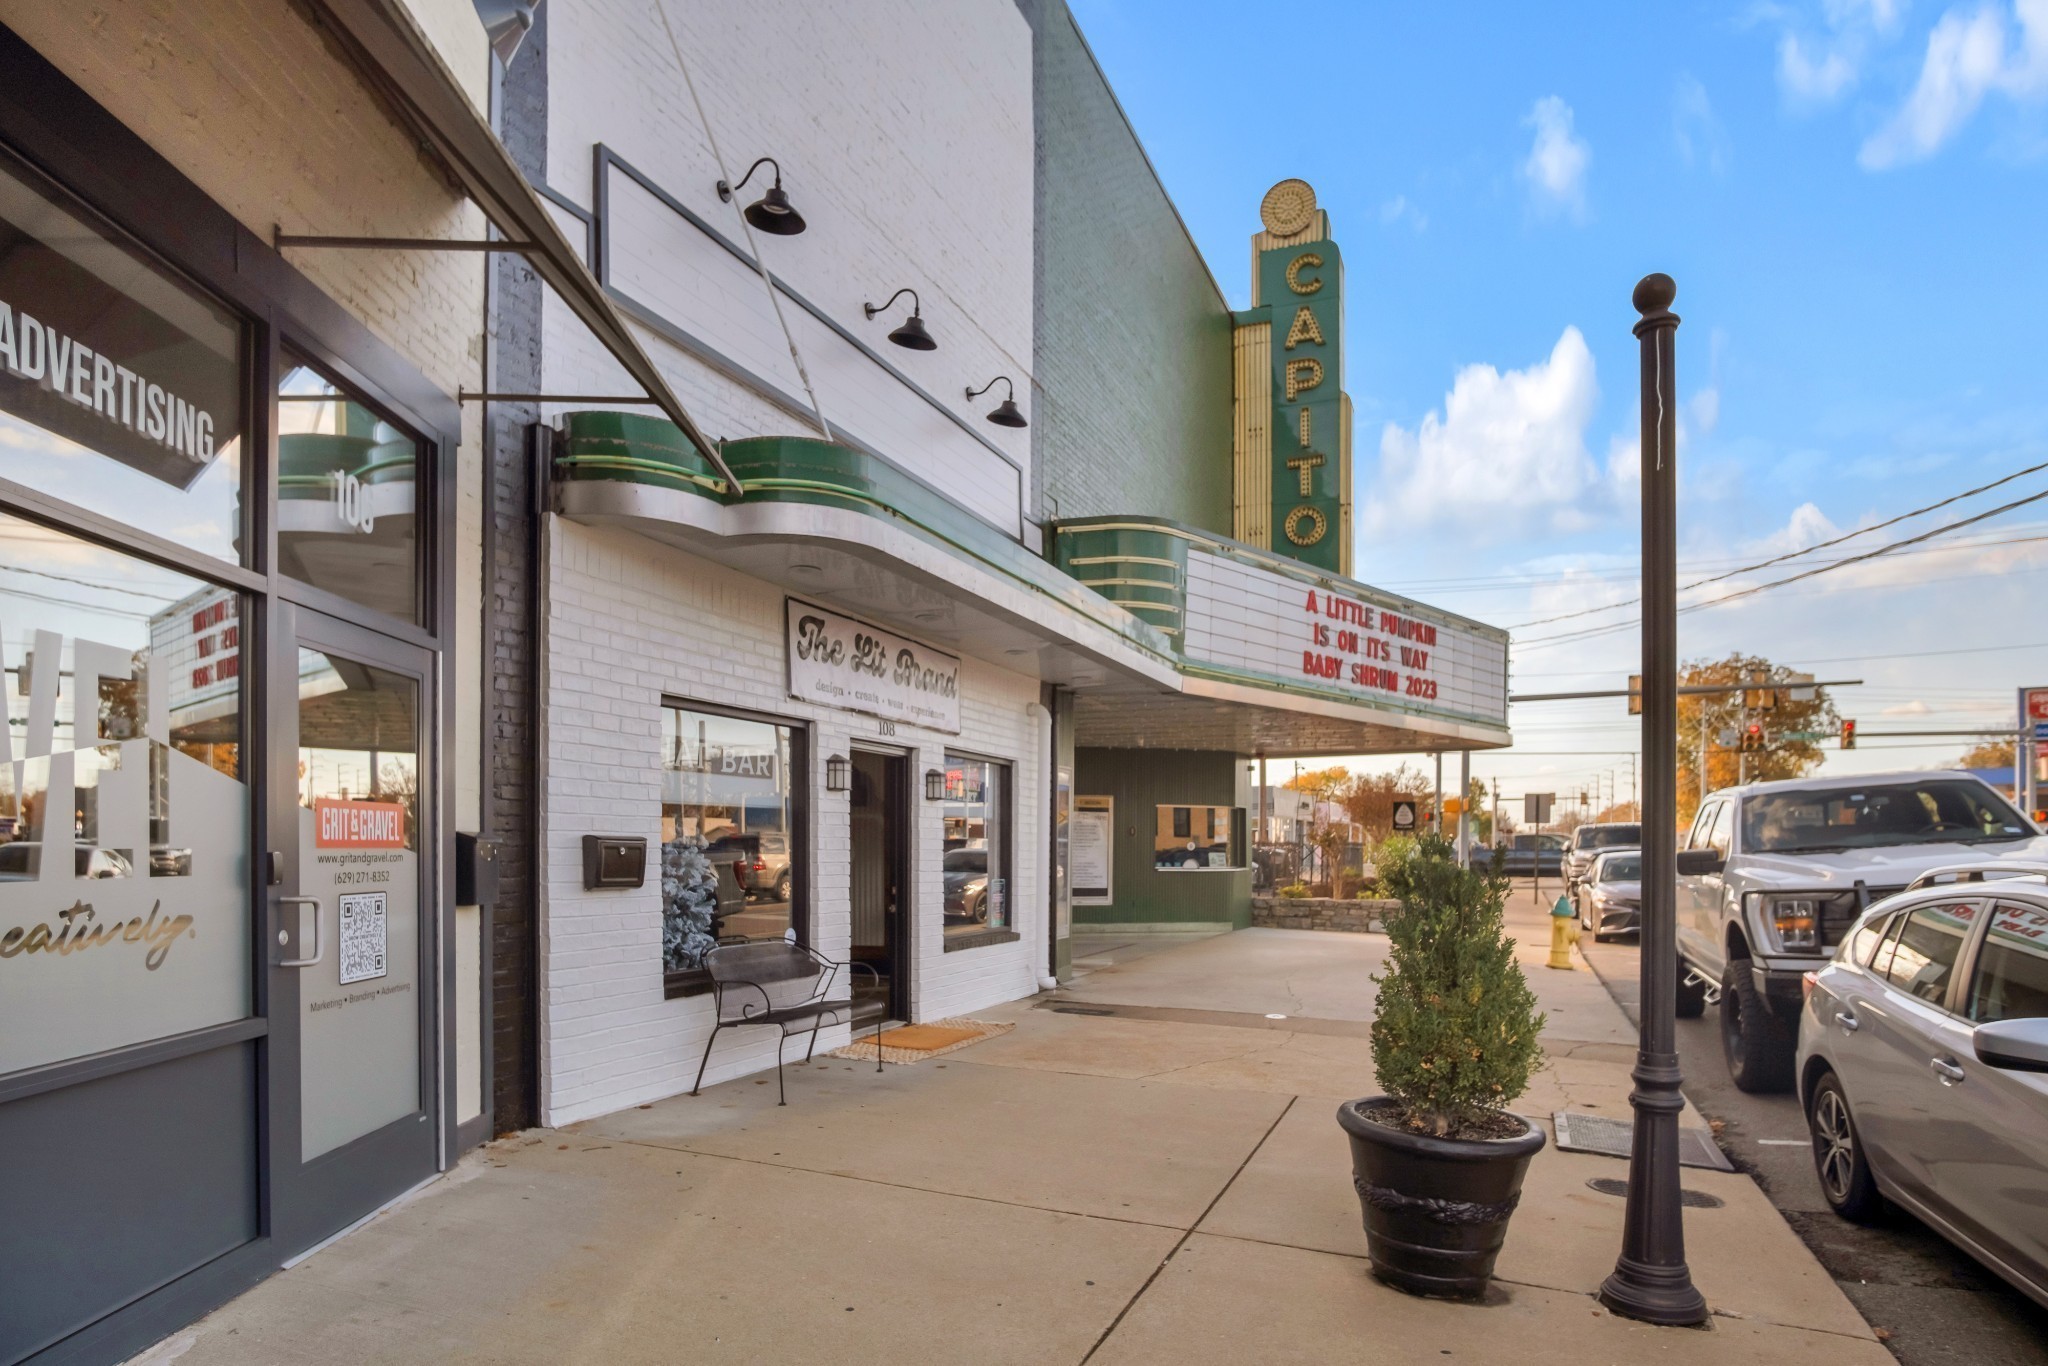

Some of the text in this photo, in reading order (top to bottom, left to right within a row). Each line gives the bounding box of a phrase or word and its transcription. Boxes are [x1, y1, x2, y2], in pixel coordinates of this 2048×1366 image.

[0, 301, 214, 464] ADVERTISING
[1285, 253, 1326, 558] CAPITO
[1306, 590, 1437, 647] A LITTLE PUMPKIN
[797, 615, 958, 699] The Lit Brand
[1313, 622, 1428, 671] IS ON ITS WAY
[815, 678, 844, 697] design
[1303, 651, 1437, 700] BABY SHRUM 2023
[878, 720, 896, 737] 108
[720, 747, 772, 777] BAR
[317, 851, 404, 867] www.gritandgravel.com
[334, 870, 390, 885] (629) 271-8352
[310, 983, 411, 1013] Marketing Branding Advertising
